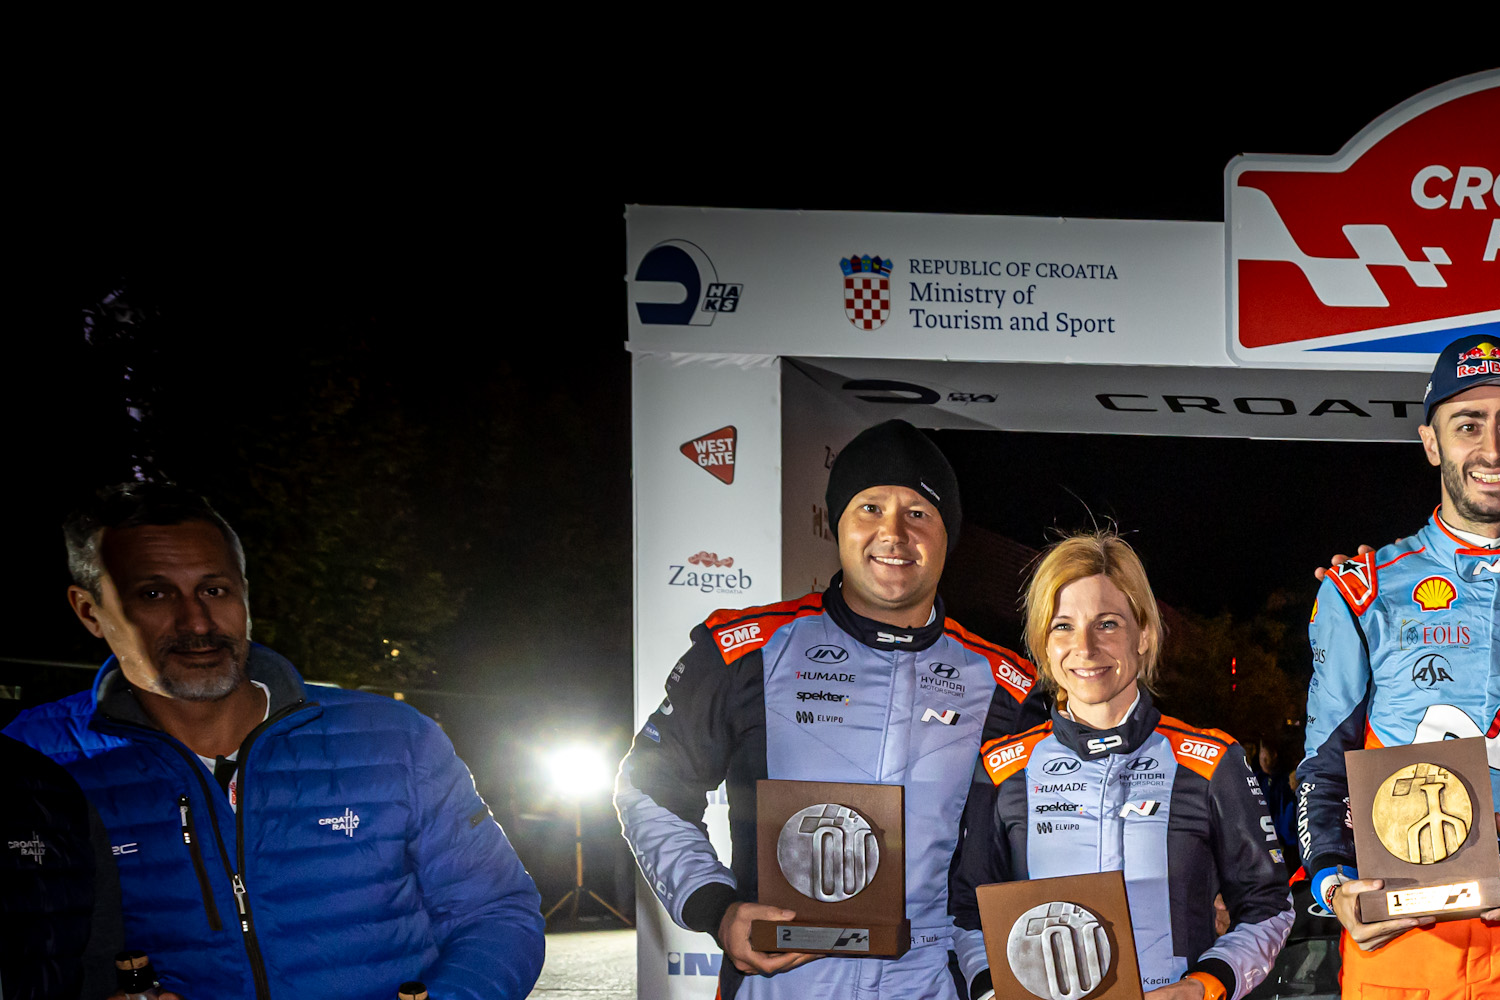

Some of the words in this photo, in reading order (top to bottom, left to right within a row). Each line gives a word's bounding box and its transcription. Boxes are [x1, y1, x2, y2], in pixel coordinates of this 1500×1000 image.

[909, 259, 1001, 277] REPUBLIC
[1006, 262, 1032, 278] OF
[1036, 262, 1118, 280] CROATIA
[909, 281, 1005, 307] Ministry
[1012, 284, 1036, 305] of
[909, 308, 1003, 333] Tourism
[1009, 311, 1049, 333] and
[1055, 312, 1116, 337] Sport
[1456, 361, 1486, 378] Red
[1095, 393, 1425, 419] CROAT
[693, 438, 733, 455] WEST
[698, 450, 735, 468] GATE
[668, 565, 752, 593] Zagreb
[720, 625, 761, 648] OMP
[921, 676, 965, 692] HYUNDAI
[998, 666, 1032, 691] OMP
[796, 691, 844, 702] spekter
[920, 684, 965, 698] MOTORSPORT
[817, 714, 843, 723] ELVIPO
[988, 745, 1026, 769] OMP
[1180, 742, 1219, 759] OMP
[1035, 802, 1079, 814] spekter
[319, 815, 359, 825] CROATIA
[332, 821, 359, 831] RALLY
[1055, 823, 1079, 831] ELVIPO
[21, 848, 45, 856] RALLY
[1394, 895, 1402, 907] 1
[782, 929, 791, 941] 2
[920, 935, 939, 944] Turk
[1143, 976, 1170, 985] Kacin
